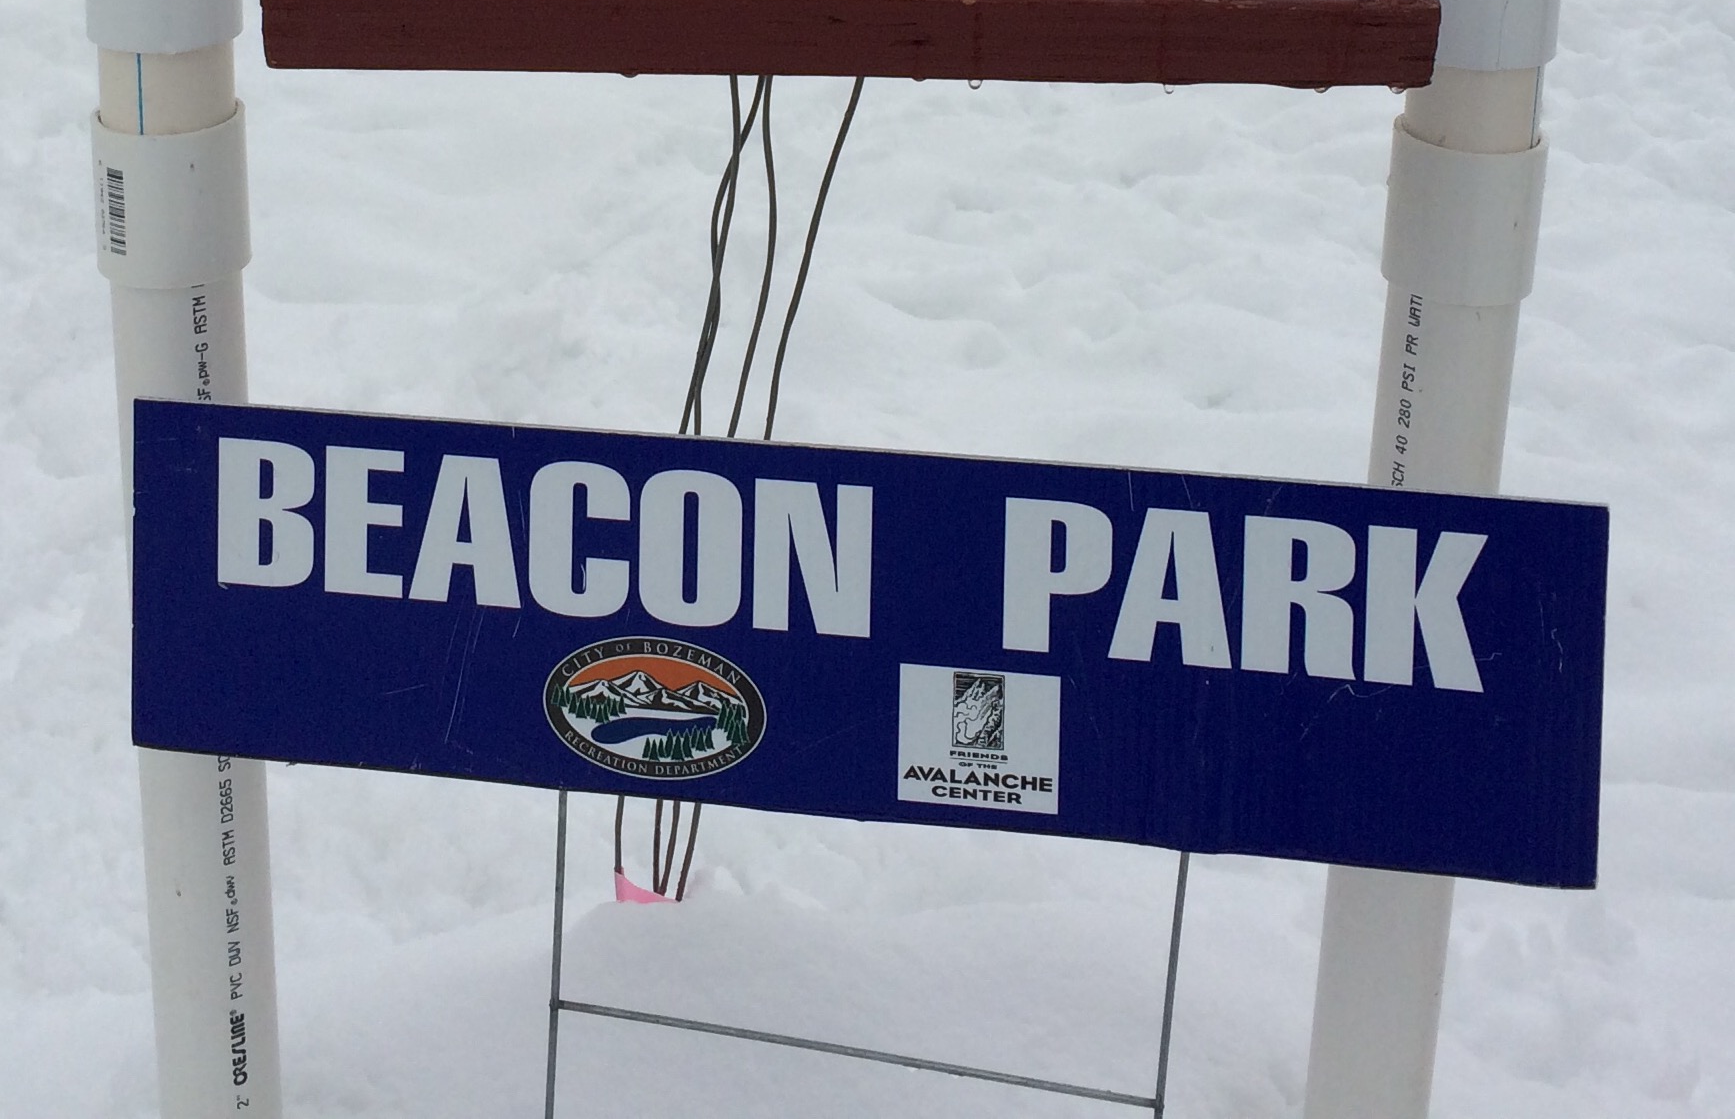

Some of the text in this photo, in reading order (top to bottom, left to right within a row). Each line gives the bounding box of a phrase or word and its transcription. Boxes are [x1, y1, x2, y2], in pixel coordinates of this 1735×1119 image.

[192, 295, 207, 335] ASTM
[1405, 333, 1419, 356] PR
[1401, 363, 1416, 393] PSI
[1398, 398, 1412, 429] 280
[1395, 435, 1408, 455] 40
[217, 436, 1489, 693] BEACON PARK
[561, 646, 605, 678] CITY
[643, 641, 742, 685] BOZEMAN
[564, 730, 744, 775] RECREATION DEPARTMENT
[949, 750, 1009, 761] FRIENDS
[903, 765, 1053, 793] AVALANCHE
[219, 778, 234, 824] D2665
[931, 785, 1022, 805] CENTER
[222, 829, 236, 866] ASTM
[229, 972, 243, 1001] PVC
